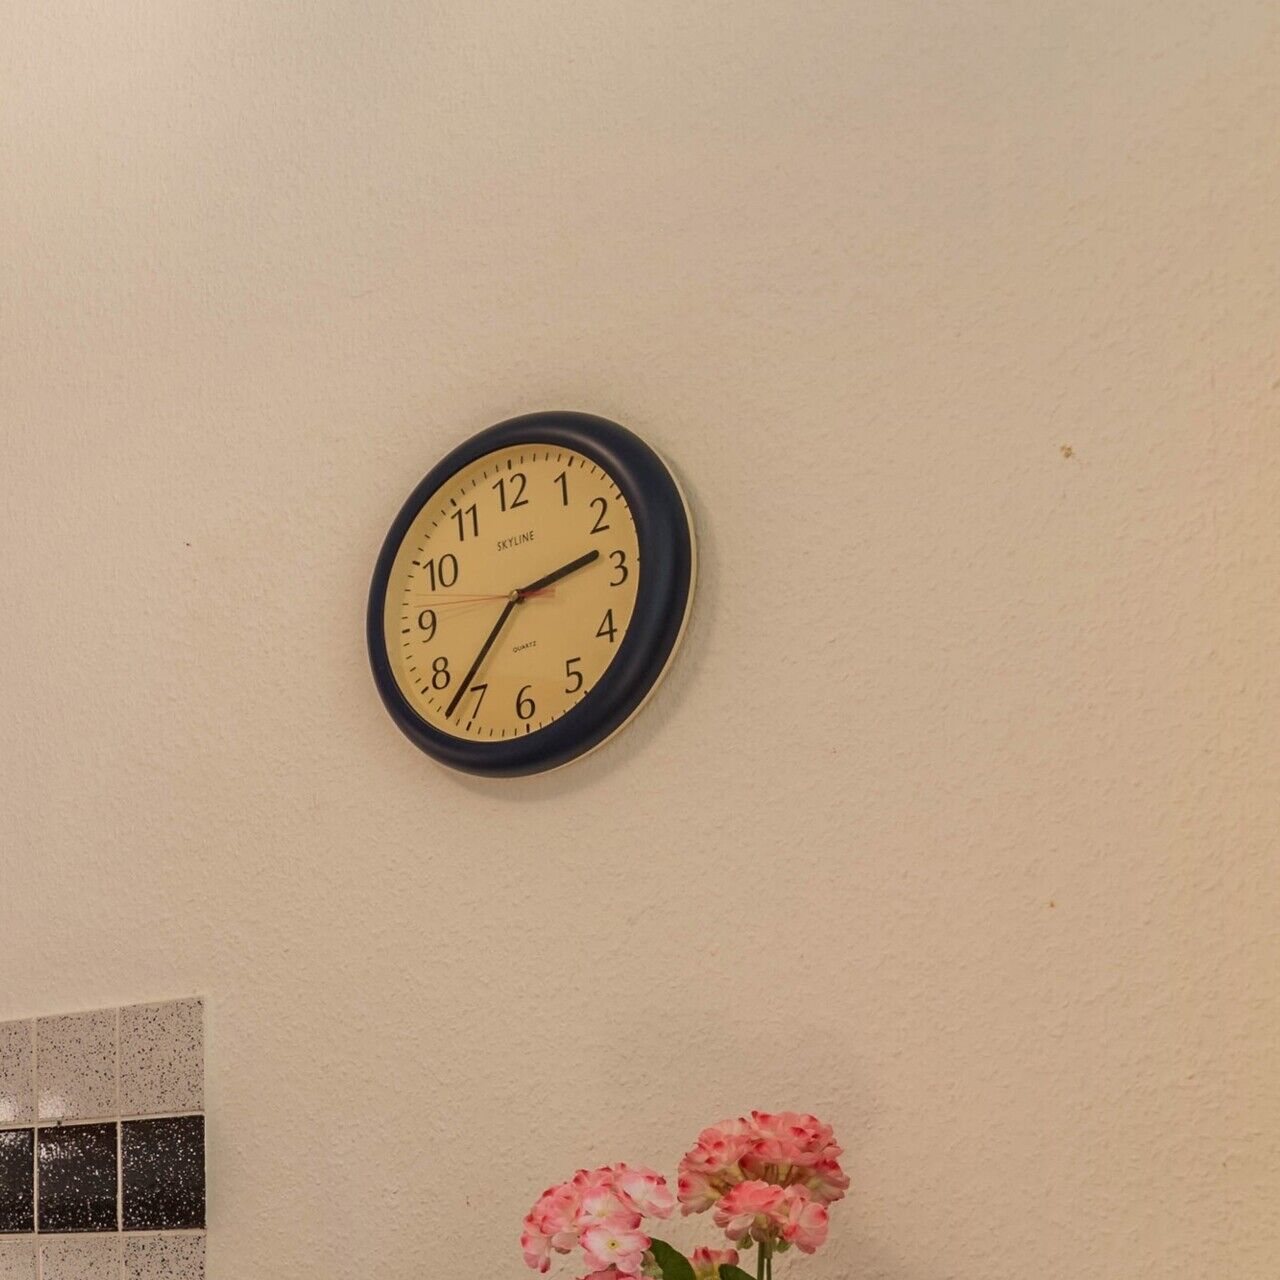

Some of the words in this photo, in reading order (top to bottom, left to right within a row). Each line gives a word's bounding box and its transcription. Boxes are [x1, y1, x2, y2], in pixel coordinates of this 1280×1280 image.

[493, 473, 529, 512] 12
[554, 472, 569, 506] 1
[451, 503, 479, 541] 11
[590, 497, 610, 534] 2
[497, 530, 535, 552] SKYLINE
[423, 554, 458, 591] 10
[609, 550, 629, 586] 3
[418, 610, 437, 642] 9
[596, 609, 617, 643] 4
[512, 640, 537, 653] QUARTZ
[431, 657, 451, 689] 8
[565, 657, 583, 694] 5
[470, 684, 488, 719] 7
[515, 685, 536, 720] 6
